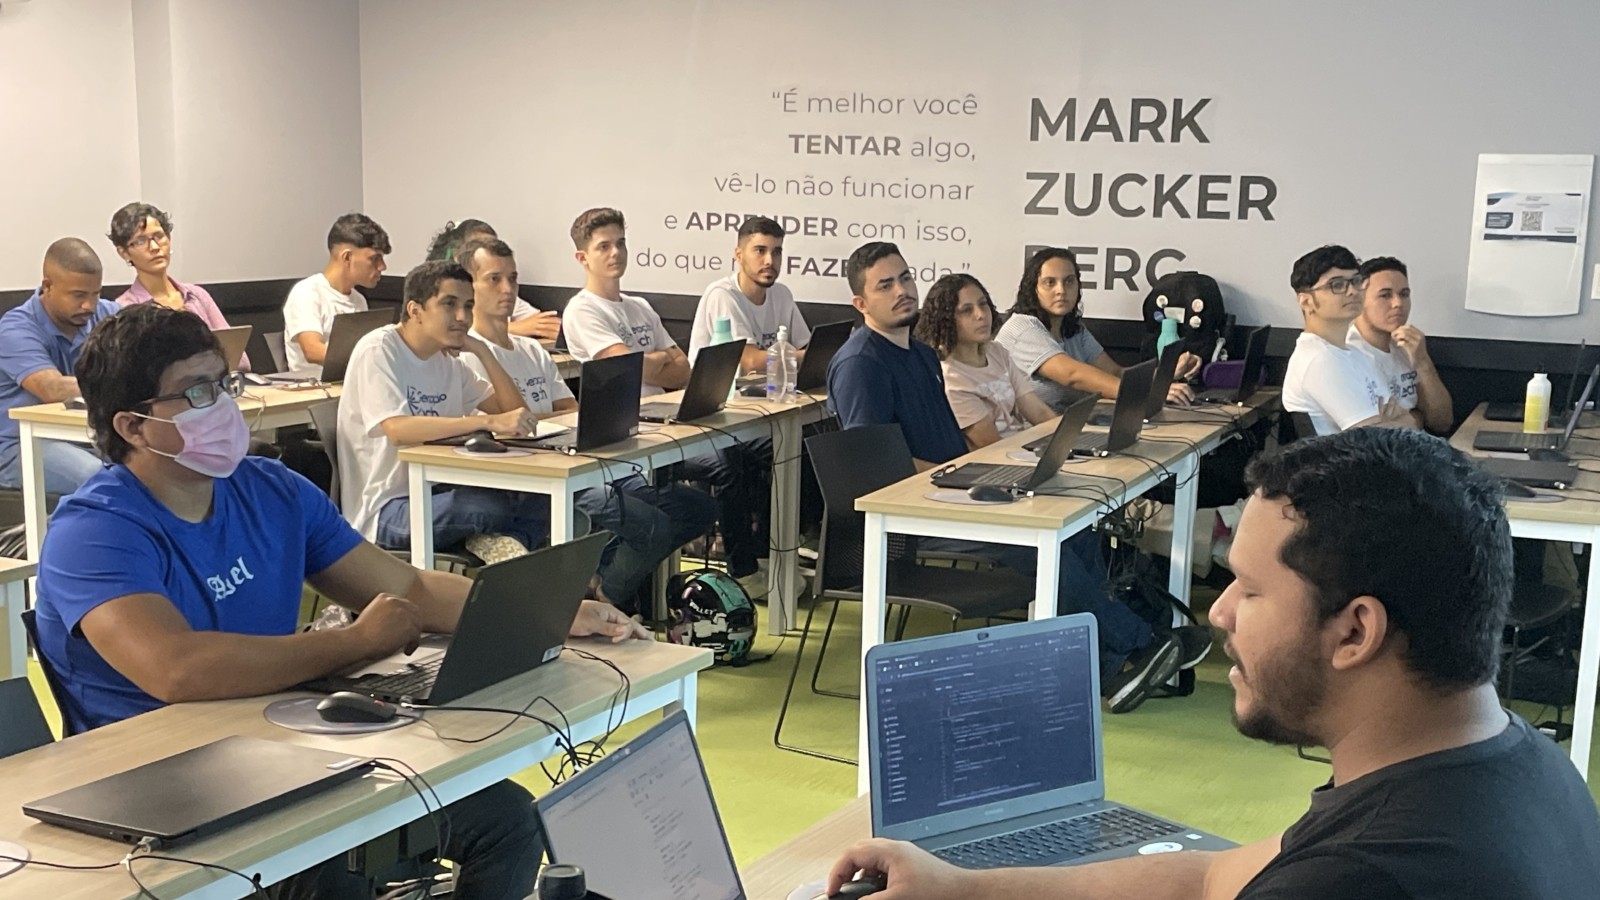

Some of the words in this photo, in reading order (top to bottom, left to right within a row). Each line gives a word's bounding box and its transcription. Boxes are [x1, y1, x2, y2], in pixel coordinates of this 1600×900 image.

[807, 92, 905, 114] melhor
[913, 93, 978, 115] você
[1029, 97, 1212, 143] MARK
[788, 134, 901, 156] TENTAR
[910, 136, 976, 163] algo,
[714, 173, 776, 194] vê-lo
[785, 175, 834, 196] não
[842, 176, 975, 200] funcionar
[1024, 172, 1278, 221] ZUCKER
[664, 215, 678, 230] e
[685, 211, 838, 237] APRDER
[847, 222, 906, 240] com
[916, 220, 972, 246] isso,
[636, 248, 667, 268] do
[675, 254, 723, 273] que
[786, 256, 849, 278] FAZE
